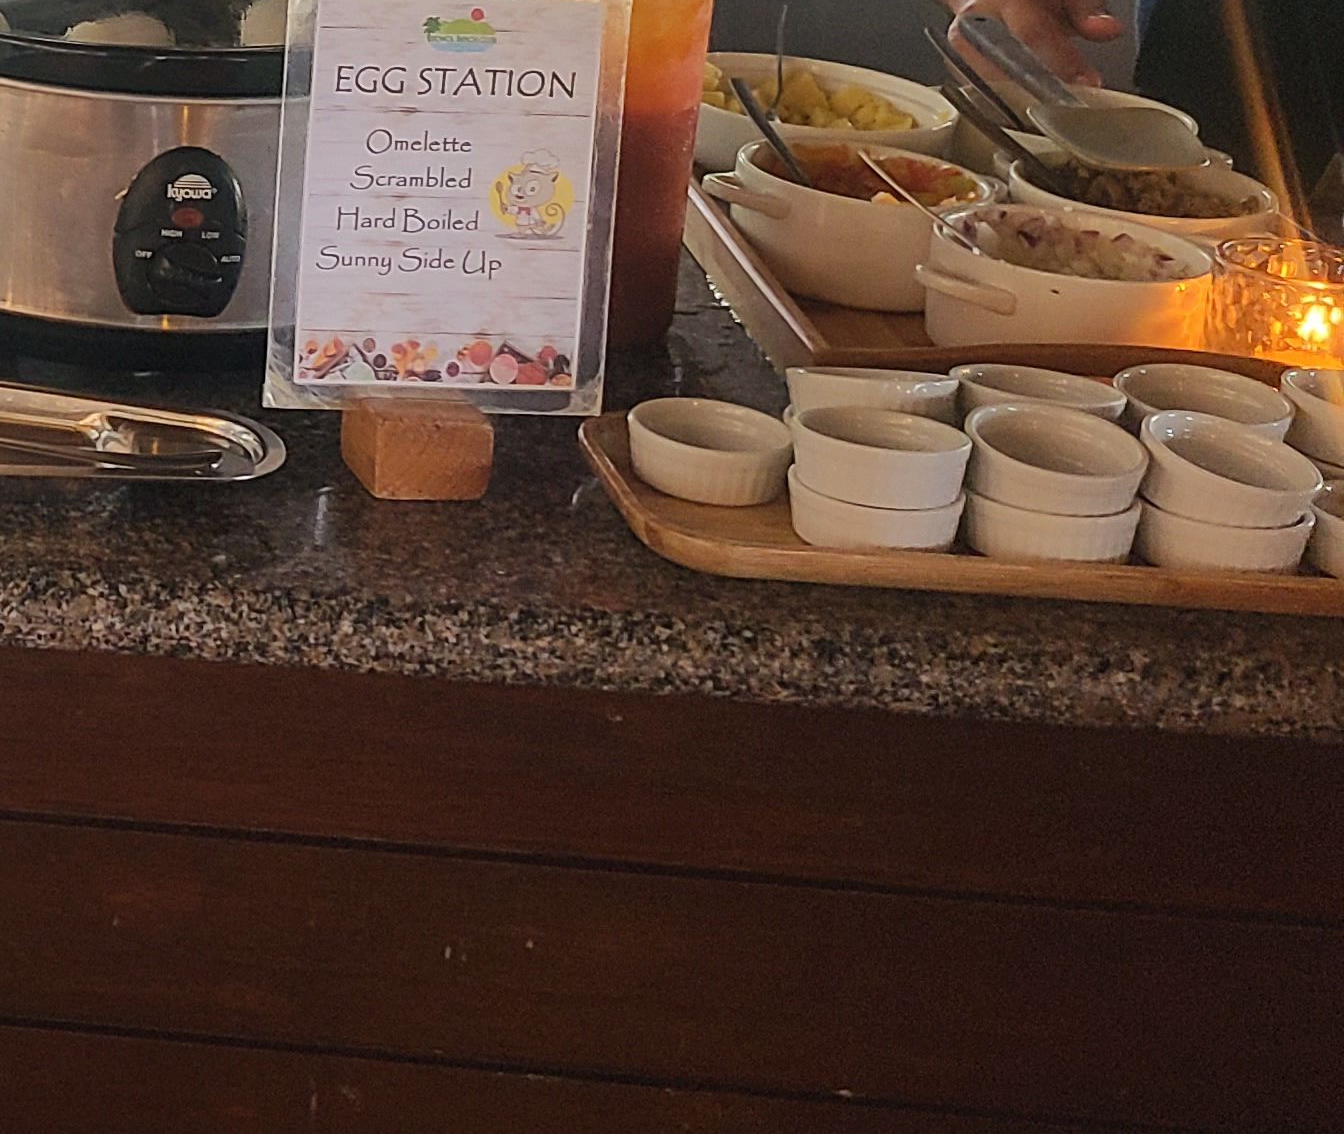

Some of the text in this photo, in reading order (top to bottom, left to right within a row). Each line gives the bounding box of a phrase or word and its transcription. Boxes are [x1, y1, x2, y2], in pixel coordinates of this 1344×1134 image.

[334, 65, 577, 99] EGG STATION
[365, 128, 473, 155] Omelette
[349, 165, 472, 190] Scrambled
[335, 206, 479, 234] Hard Boiled
[315, 245, 502, 280] Sunny Side Up
